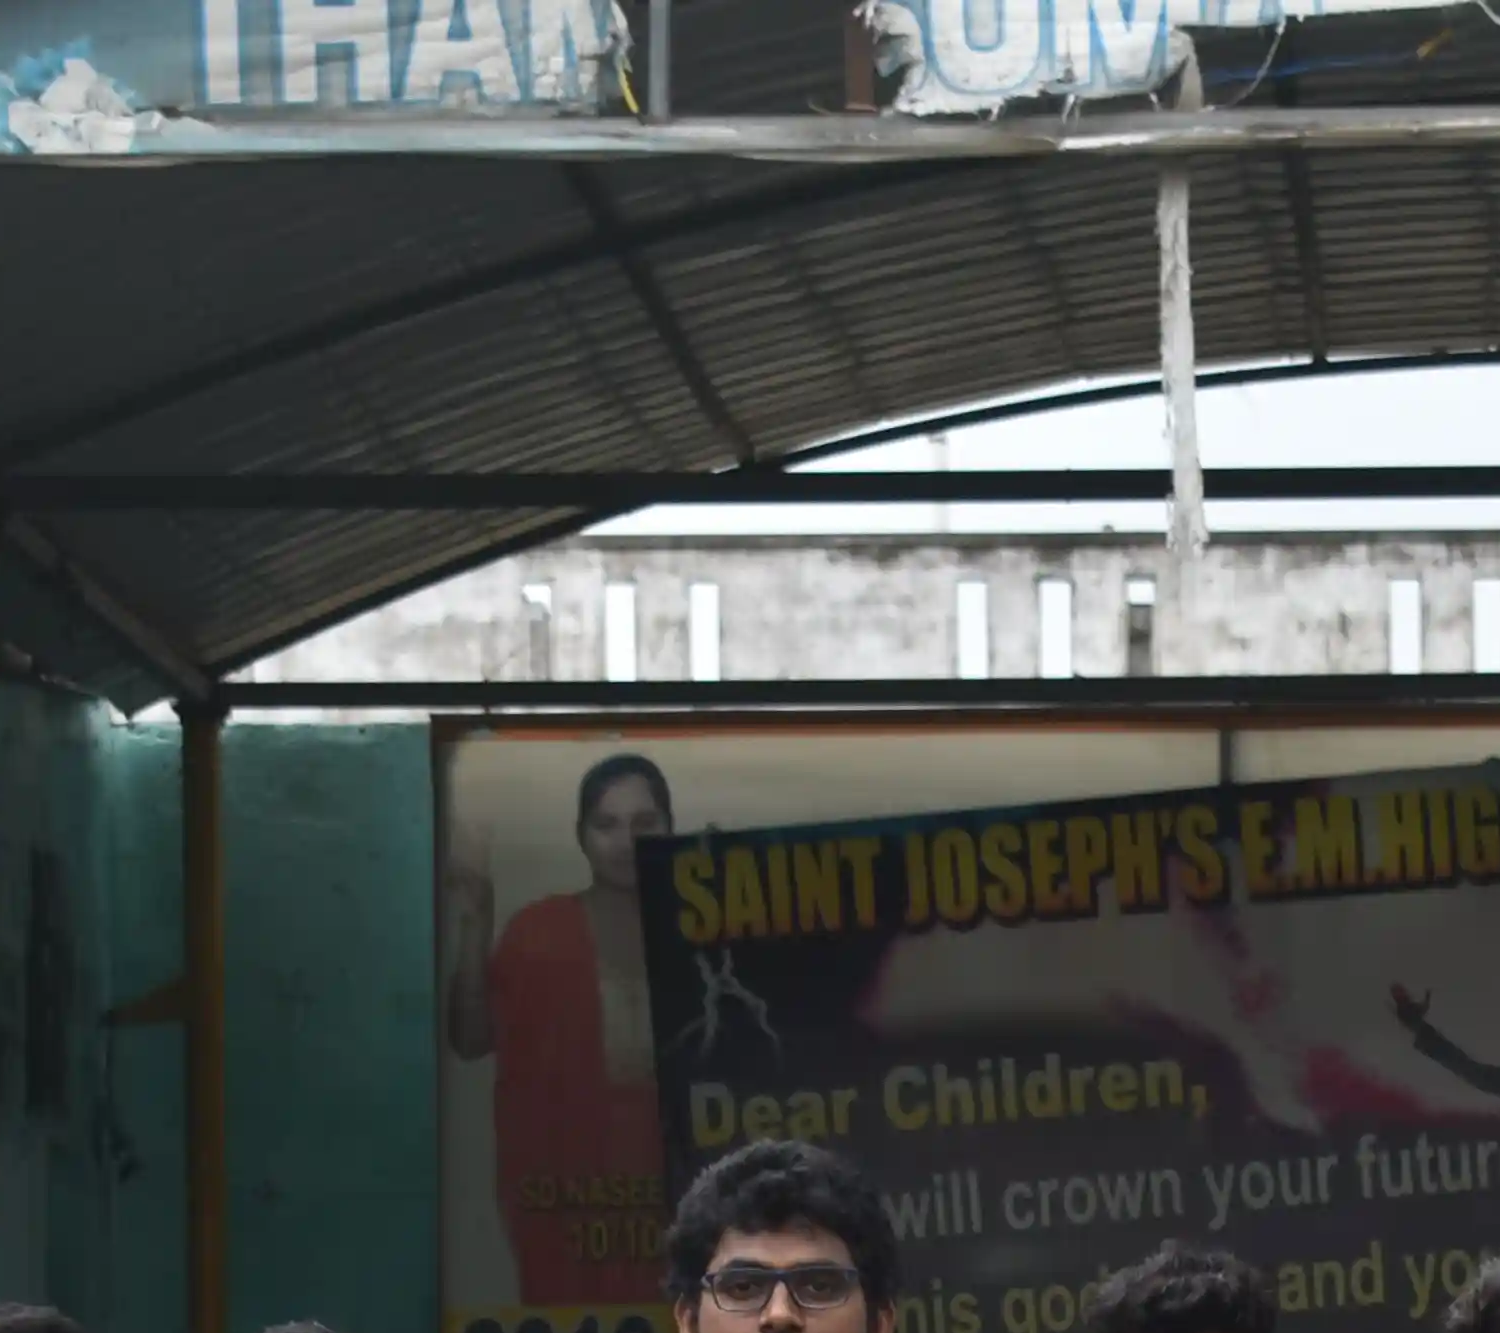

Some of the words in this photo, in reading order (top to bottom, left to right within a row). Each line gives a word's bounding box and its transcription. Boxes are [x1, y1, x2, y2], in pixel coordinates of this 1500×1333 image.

[671, 836, 882, 944] SAINT
[903, 804, 1226, 928] JOSEPH'S
[689, 1081, 858, 1149] Dear
[882, 1050, 1212, 1132] Children,
[880, 1168, 984, 1241] will
[1002, 1167, 1184, 1231] crown
[1202, 1153, 1339, 1231] your
[1277, 1239, 1386, 1313] and
[1404, 1249, 1480, 1320] yo
